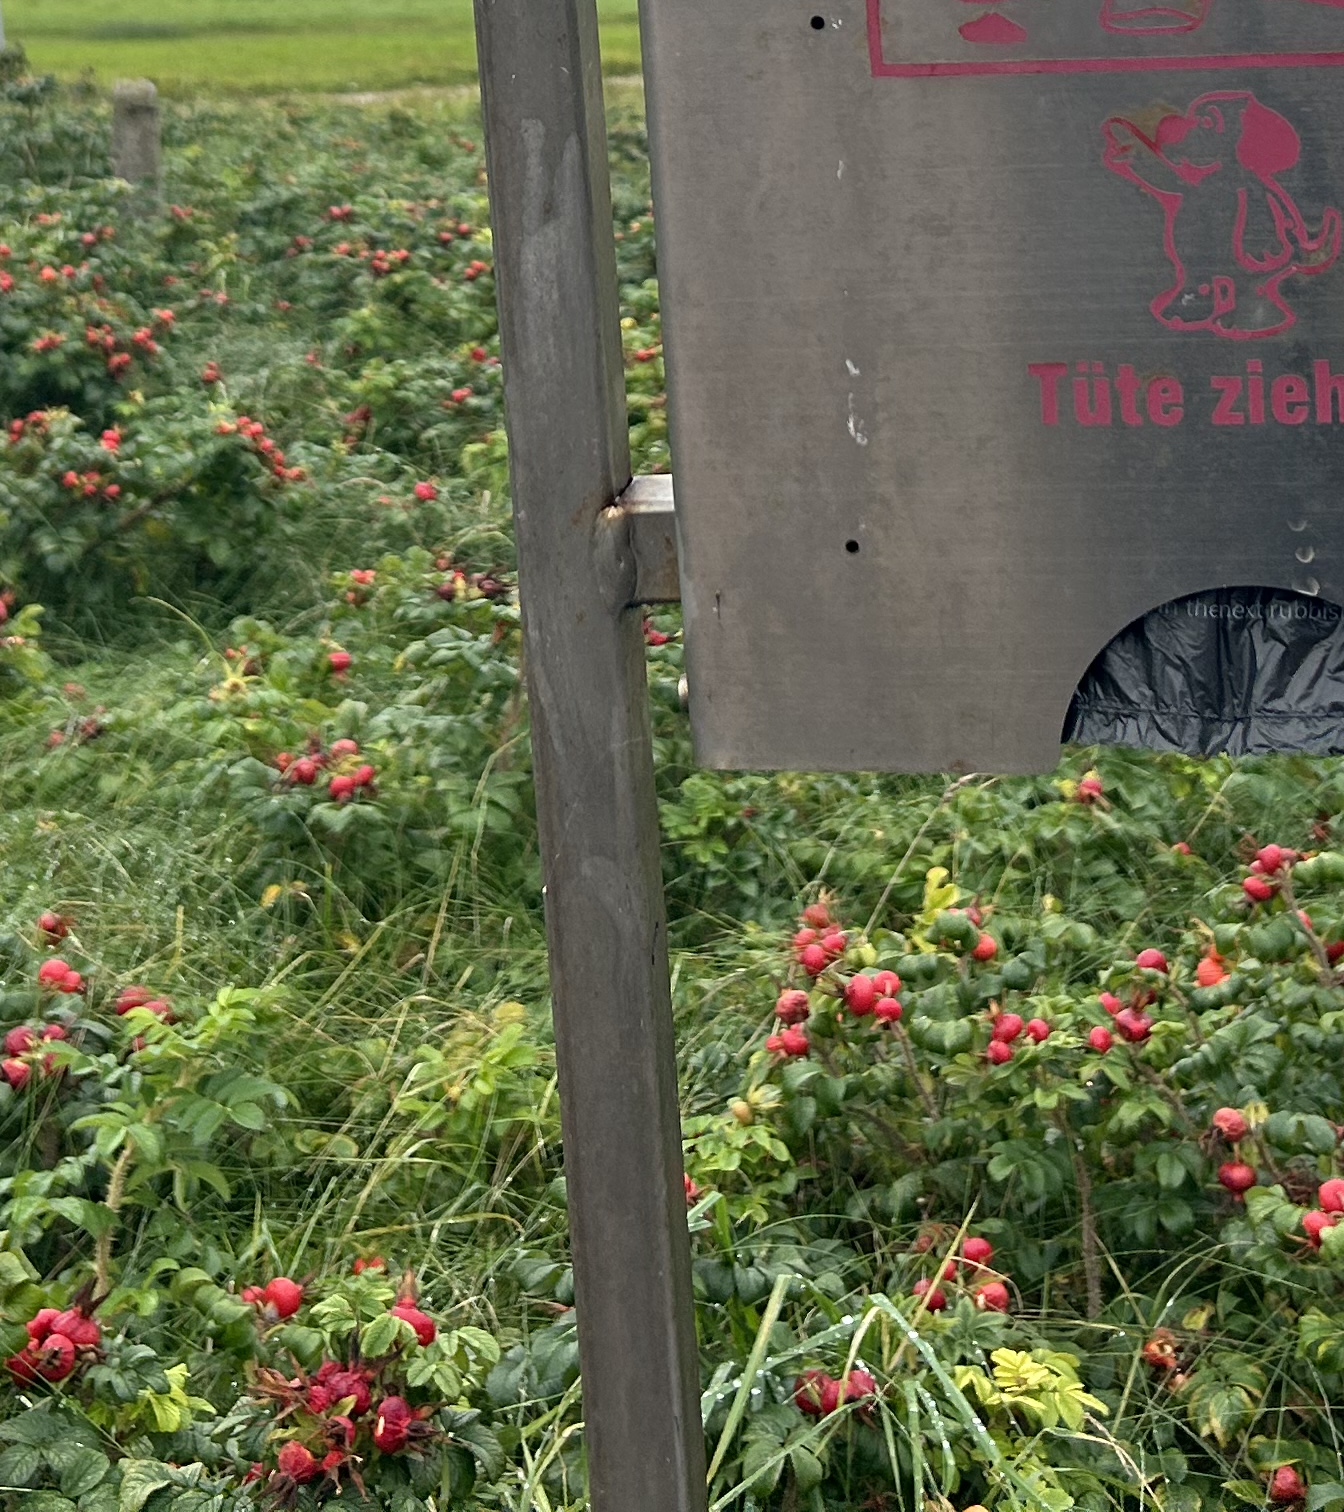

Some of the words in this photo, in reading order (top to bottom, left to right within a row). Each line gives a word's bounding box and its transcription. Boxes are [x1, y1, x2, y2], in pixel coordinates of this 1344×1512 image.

[1027, 361, 1185, 427] Tüte
[1186, 598, 1218, 618] the
[1219, 600, 1264, 619] next
